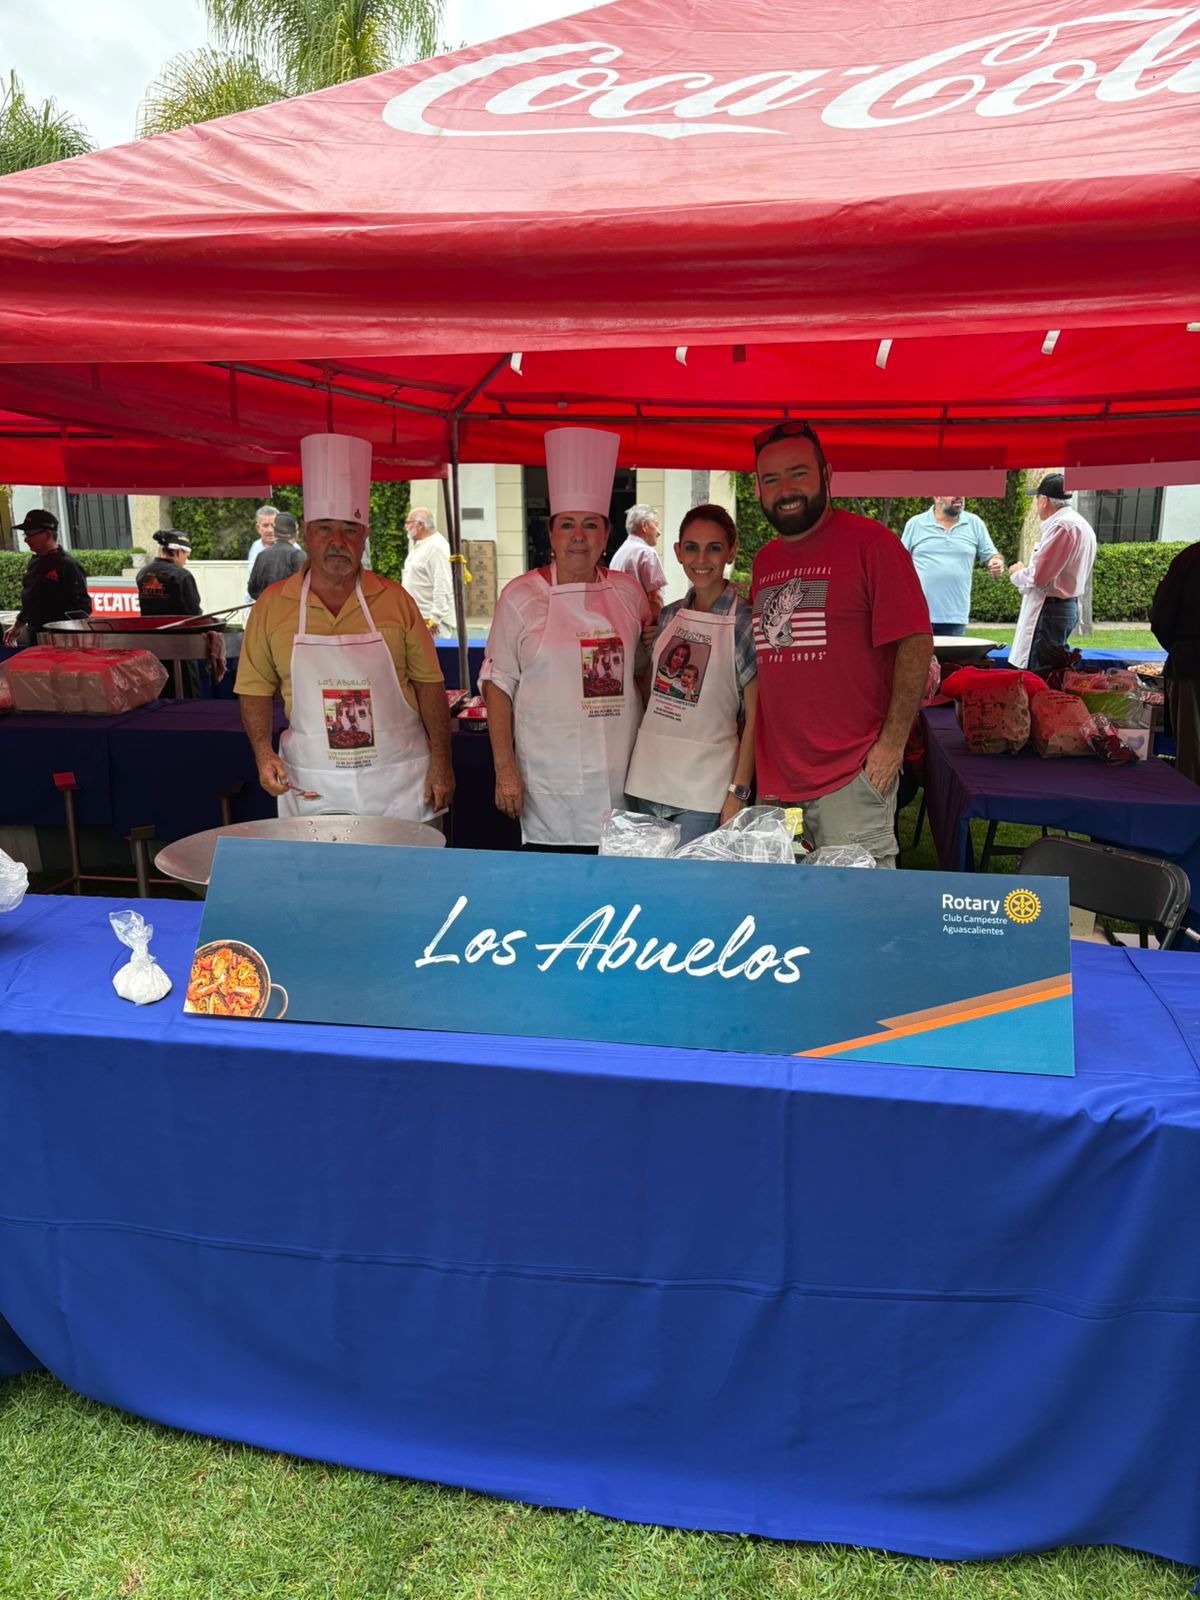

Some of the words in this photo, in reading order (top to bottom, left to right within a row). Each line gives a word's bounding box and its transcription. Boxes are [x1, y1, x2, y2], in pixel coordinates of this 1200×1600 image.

[794, 566, 832, 577] ORIGINAL
[791, 652, 824, 662] SHOPS
[942, 893, 1000, 915] Rotary
[943, 914, 962, 922] Club
[963, 915, 1008, 925] Campestre
[943, 925, 1004, 936] Aguascalientes
[414, 895, 528, 968] Los
[535, 904, 811, 984] Abuelos
